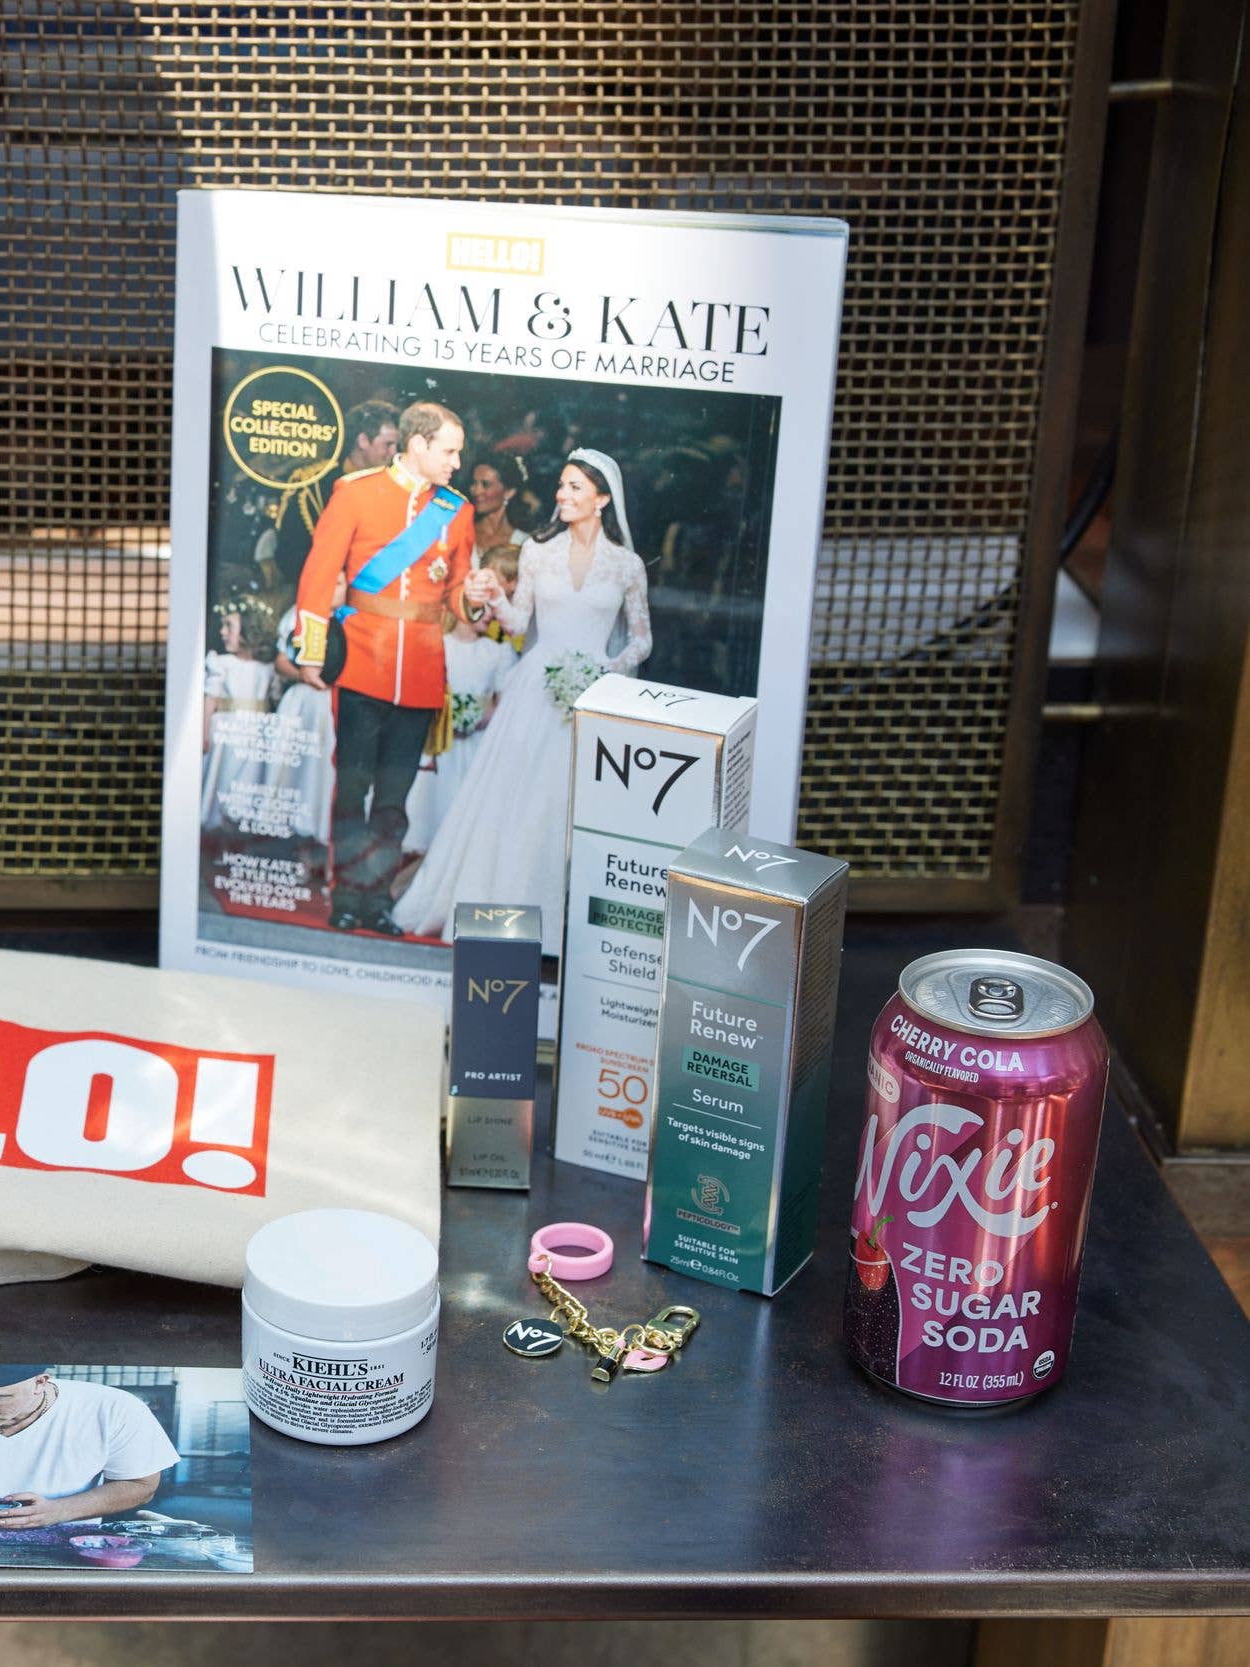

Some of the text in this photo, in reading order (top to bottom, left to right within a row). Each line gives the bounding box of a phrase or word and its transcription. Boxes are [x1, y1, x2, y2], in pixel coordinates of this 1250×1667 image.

[450, 237, 542, 272] HELLO!
[231, 265, 771, 356] WILLIAM & KATE
[259, 322, 735, 383] CELEBRATING 15 YEARS OF MARRIAGE
[252, 400, 317, 421] SPECIAL
[230, 416, 337, 441] COLLECTORS'
[249, 437, 317, 458] EDITION
[607, 854, 668, 881] Future
[606, 871, 666, 899] Renew
[593, 911, 664, 936] PROTECTIO
[607, 903, 664, 925] DAMAGE
[601, 940, 662, 966] Defense
[609, 958, 656, 981] Shield
[601, 996, 659, 1017] Lightweight
[601, 1008, 657, 1029] Moisturizer
[692, 1001, 758, 1033] Future
[690, 1019, 757, 1050] Renew
[890, 1015, 1025, 1072] CHERRY COLA
[687, 1062, 753, 1088] REVERSAL
[693, 1051, 749, 1075] DAMAGE
[904, 1051, 980, 1084] ORGANICALLY FLAVORED
[465, 1071, 523, 1082] PRO ARTIST
[597, 1068, 649, 1105] 50
[692, 1088, 744, 1114] Serum
[667, 1116, 765, 1153] Targets visible signs
[678, 1133, 751, 1161] of skin damage
[854, 1104, 1056, 1238] Nixie
[674, 1240, 739, 1265] SENSITIVE SKIN
[678, 1234, 735, 1256] SUITABLE FOR
[900, 1241, 1004, 1287] ZERO
[910, 1281, 1041, 1322] SUGAR
[922, 1320, 1030, 1354] SODA
[259, 1358, 404, 1392] ULTRA FACIAL CREAM
[273, 1352, 290, 1363] SINCE
[292, 1356, 368, 1376] KIEHL'S
[286, 1384, 301, 1394] Daily
[302, 1390, 340, 1400] Lightweight
[341, 1393, 373, 1402] Hydrating
[374, 1388, 399, 1398] Formula
[939, 1370, 1025, 1390] 12 FL OZ (355 mL)
[291, 1394, 319, 1405] Squalane
[358, 1395, 396, 1406] Glycoprotein
